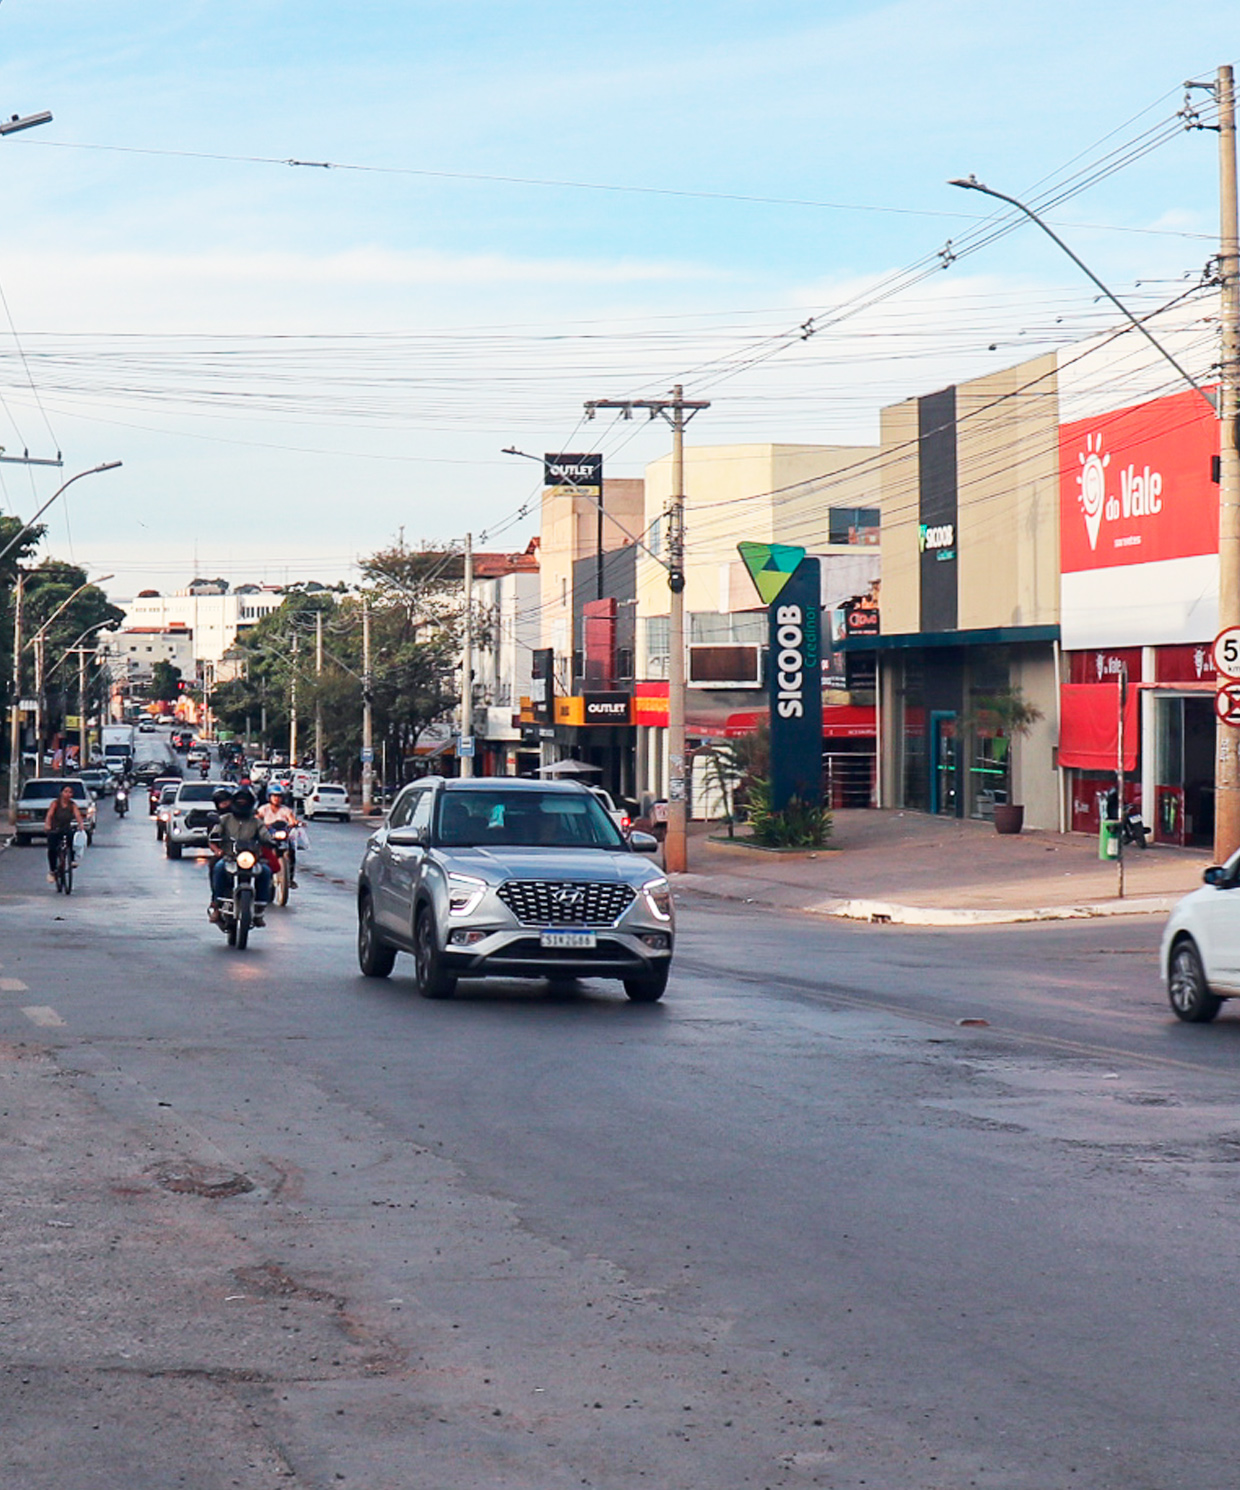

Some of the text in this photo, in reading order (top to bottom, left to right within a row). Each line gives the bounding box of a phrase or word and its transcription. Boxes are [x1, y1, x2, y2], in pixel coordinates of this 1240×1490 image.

[549, 464, 594, 476] OUTLET
[1105, 464, 1162, 521] do Vale
[777, 604, 803, 718] SICOOB
[804, 606, 817, 668] Credinor
[588, 703, 626, 713] OUTLET
